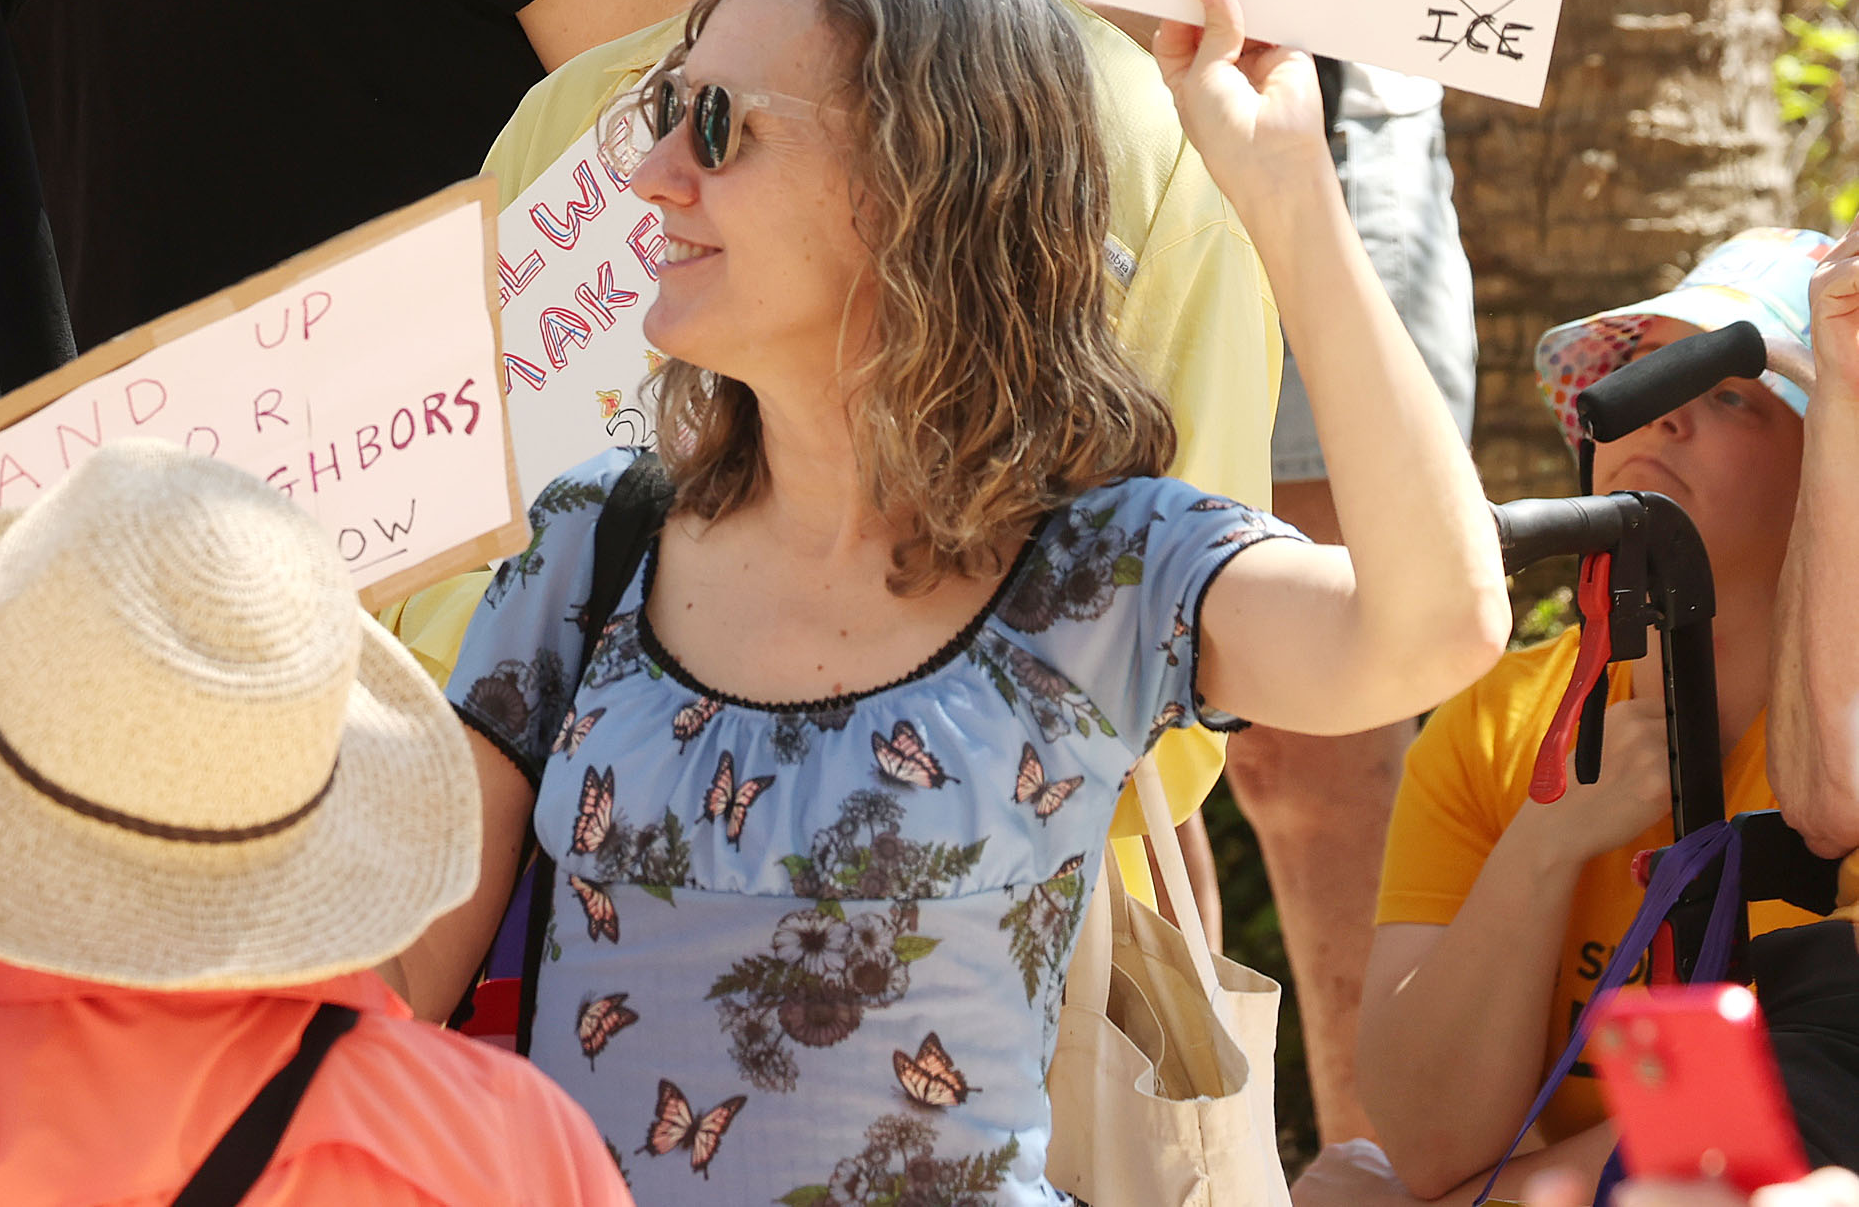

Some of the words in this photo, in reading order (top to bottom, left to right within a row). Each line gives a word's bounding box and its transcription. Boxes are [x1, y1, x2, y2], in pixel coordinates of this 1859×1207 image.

[1417, 8, 1534, 61] ICE
[255, 291, 332, 349] UP
[338, 498, 416, 561] OW
